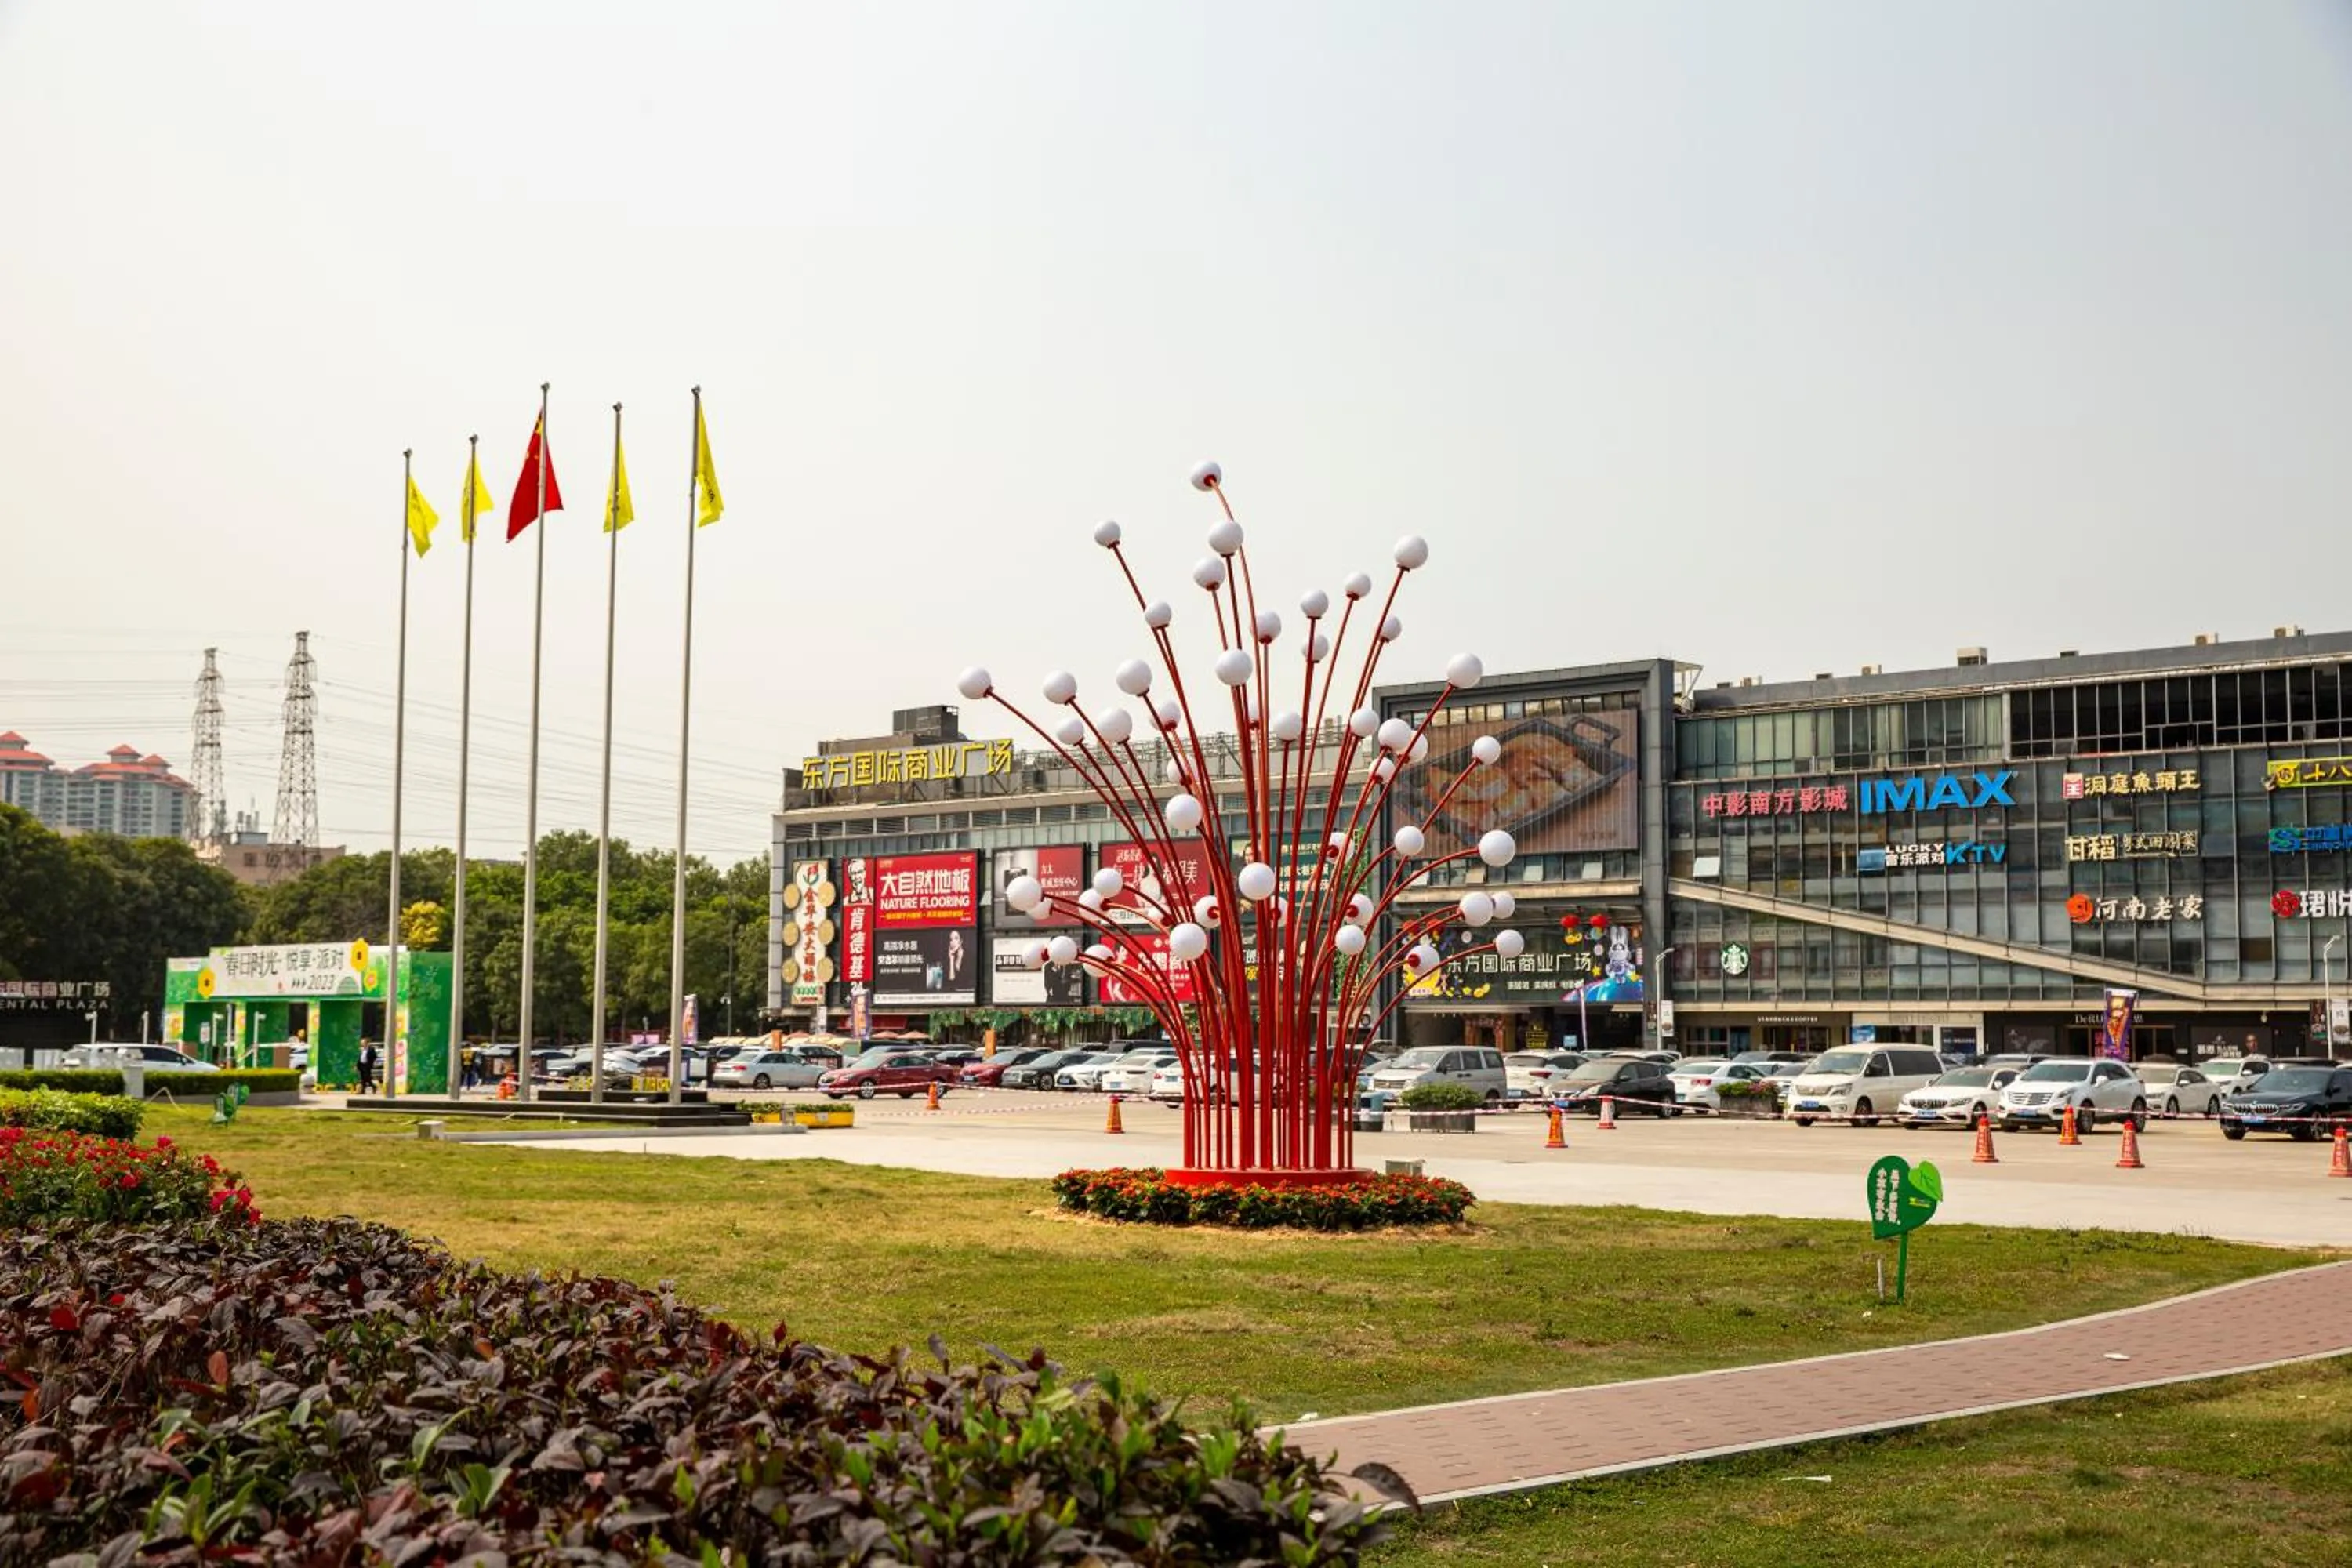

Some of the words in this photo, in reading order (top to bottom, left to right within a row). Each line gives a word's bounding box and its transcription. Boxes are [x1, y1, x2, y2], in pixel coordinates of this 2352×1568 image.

[802, 739, 1013, 790] 东方国际商业广场
[1860, 771, 2017, 814] IMAX
[2085, 769, 2201, 796] 洞庭魚頭王
[1702, 785, 1849, 818] 中影南方影城
[1885, 851, 1945, 866] 音乐派对
[1886, 843, 1945, 853] LUCKY
[1946, 840, 2007, 865] KTV
[2065, 836, 2116, 861] 甘稻
[880, 868, 971, 897] 大自然地板
[880, 898, 918, 909] NATURE
[920, 895, 970, 908] FLOORING
[2095, 894, 2204, 920] 河南老家
[849, 908, 866, 979] 肯德基
[1447, 952, 1592, 974] 东方国际商业广场
[307, 974, 336, 991] 2023
[56, 1000, 109, 1010] PLAZA
[2075, 1014, 2104, 1024] DeRU
